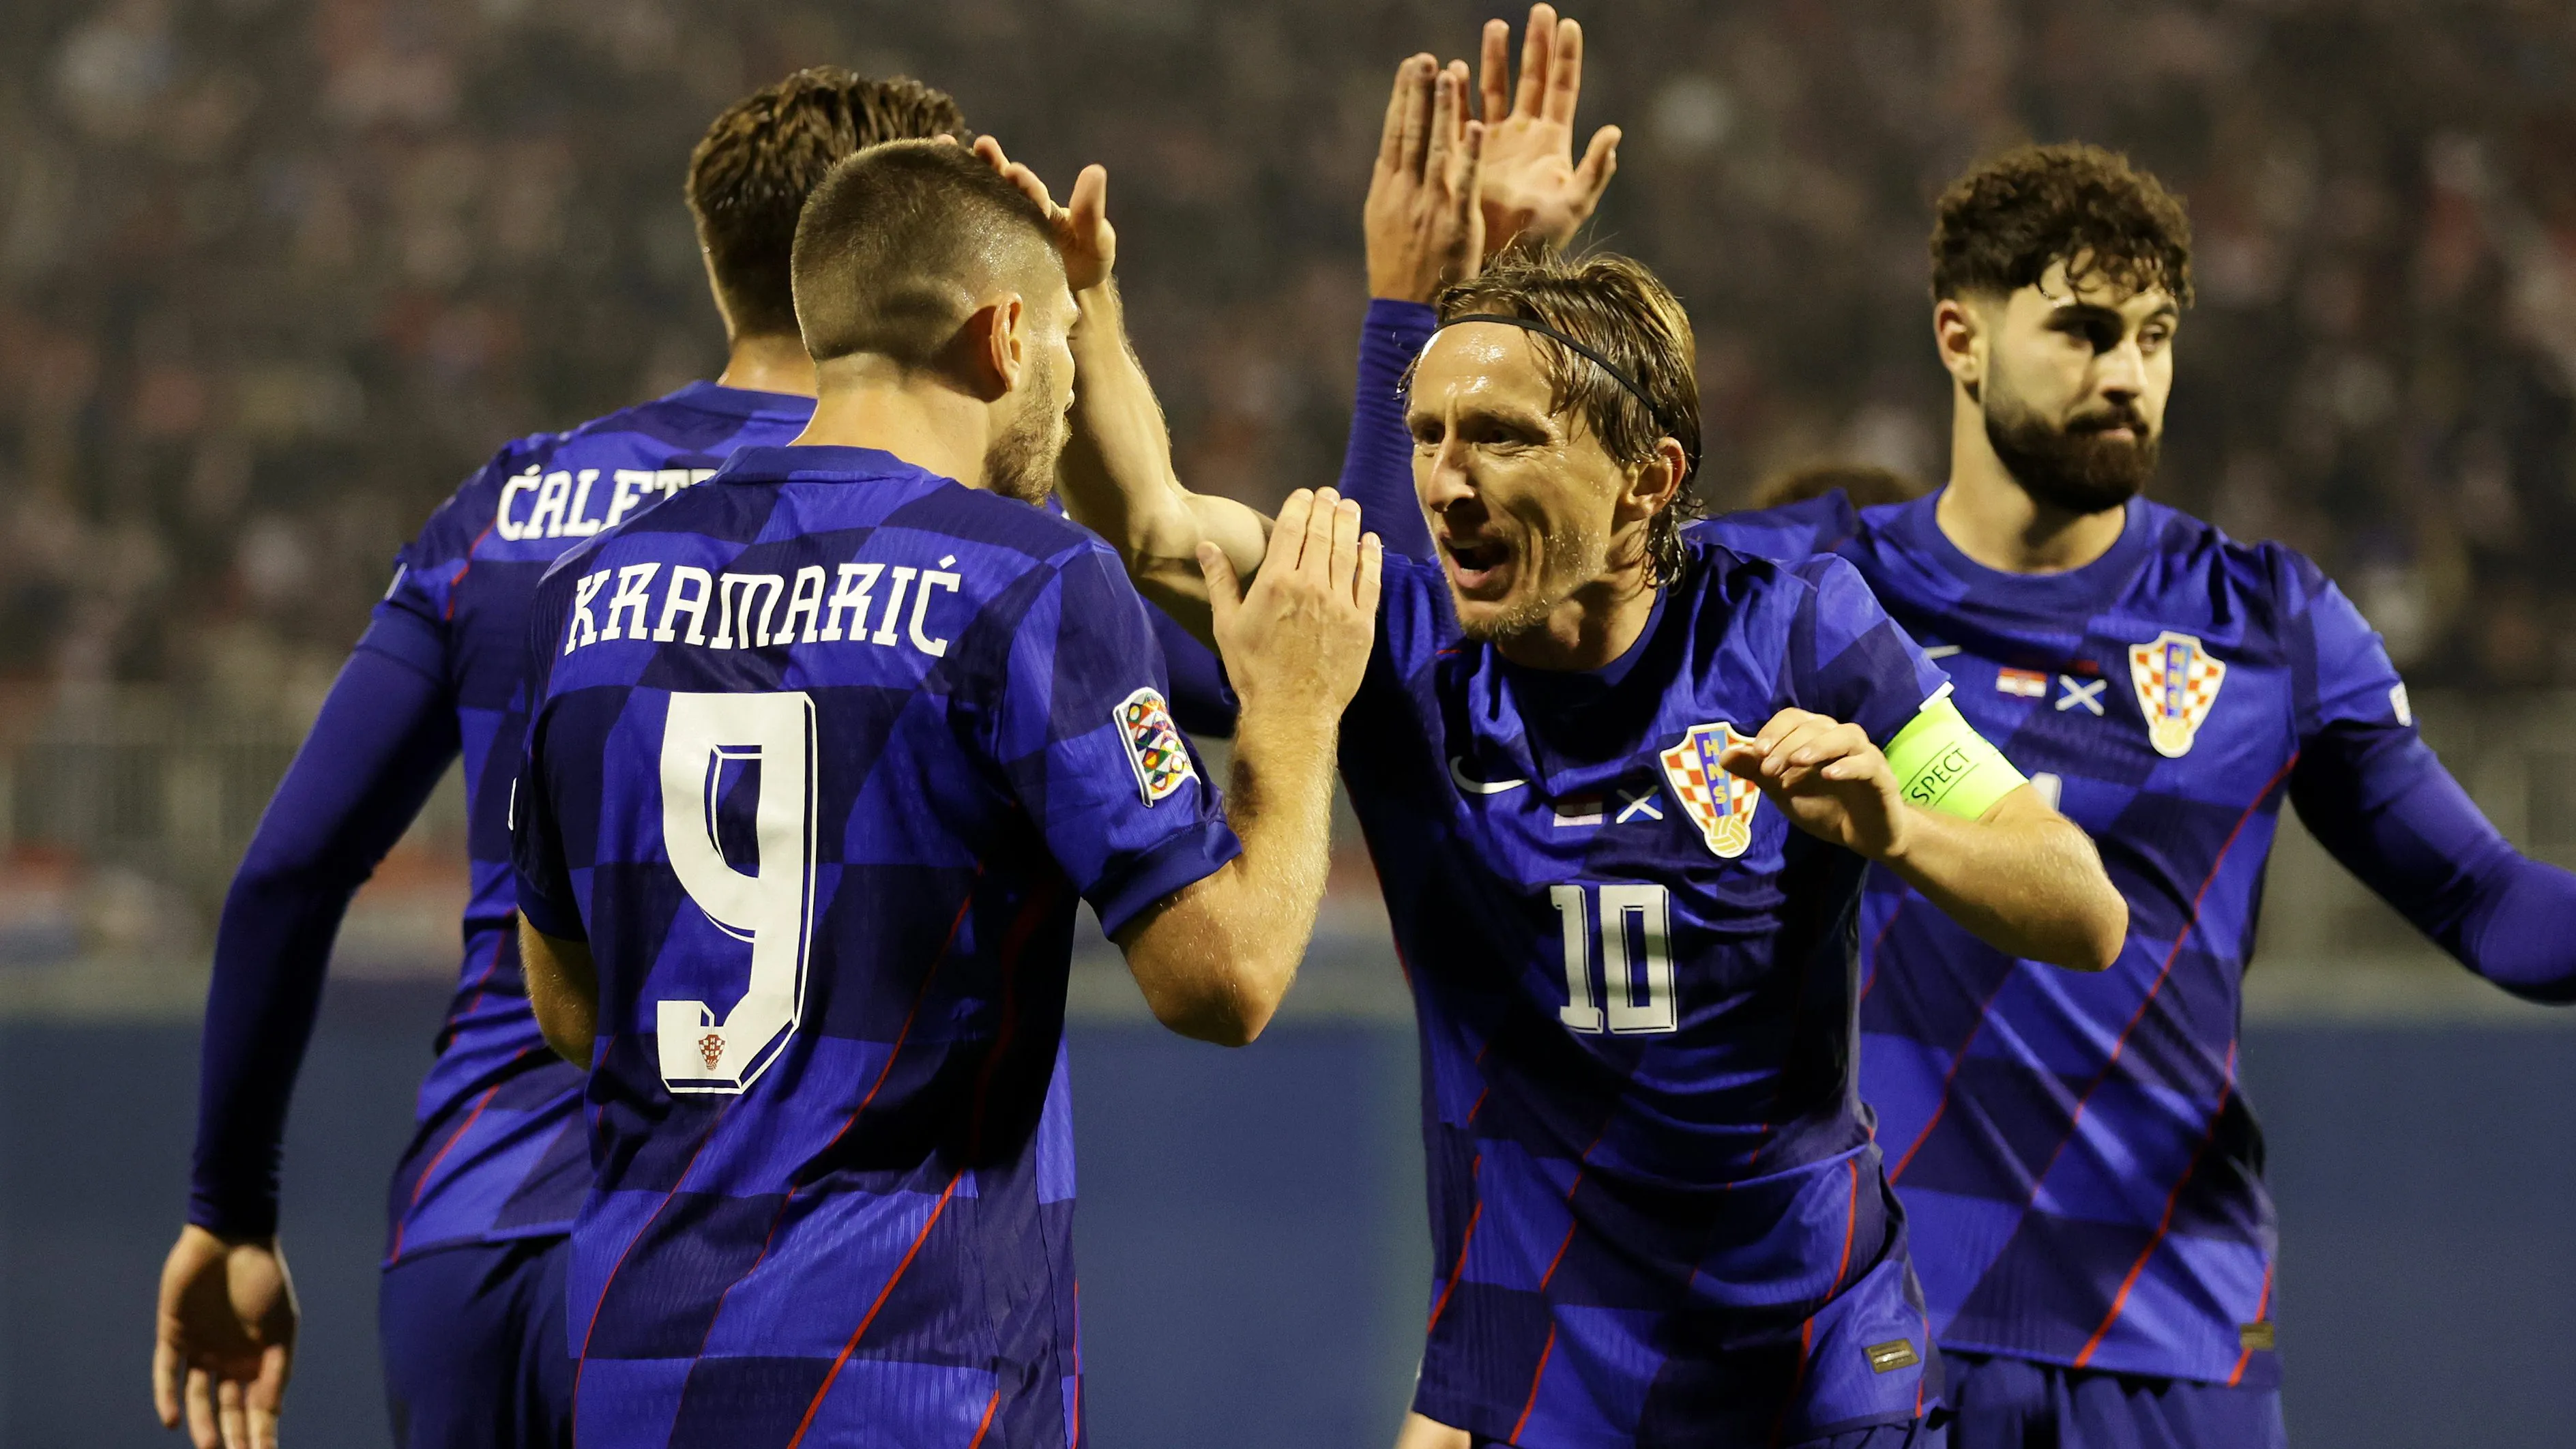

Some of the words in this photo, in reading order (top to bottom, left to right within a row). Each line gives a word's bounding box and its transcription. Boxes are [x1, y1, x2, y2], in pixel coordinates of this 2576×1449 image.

[496, 464, 719, 541] ĆALET
[564, 555, 961, 657] KRAMARIĆ
[1703, 739, 1728, 804] HNS
[1907, 748, 1970, 806] SPECT
[658, 692, 817, 1094] 9
[1549, 884, 1678, 1034] 10
